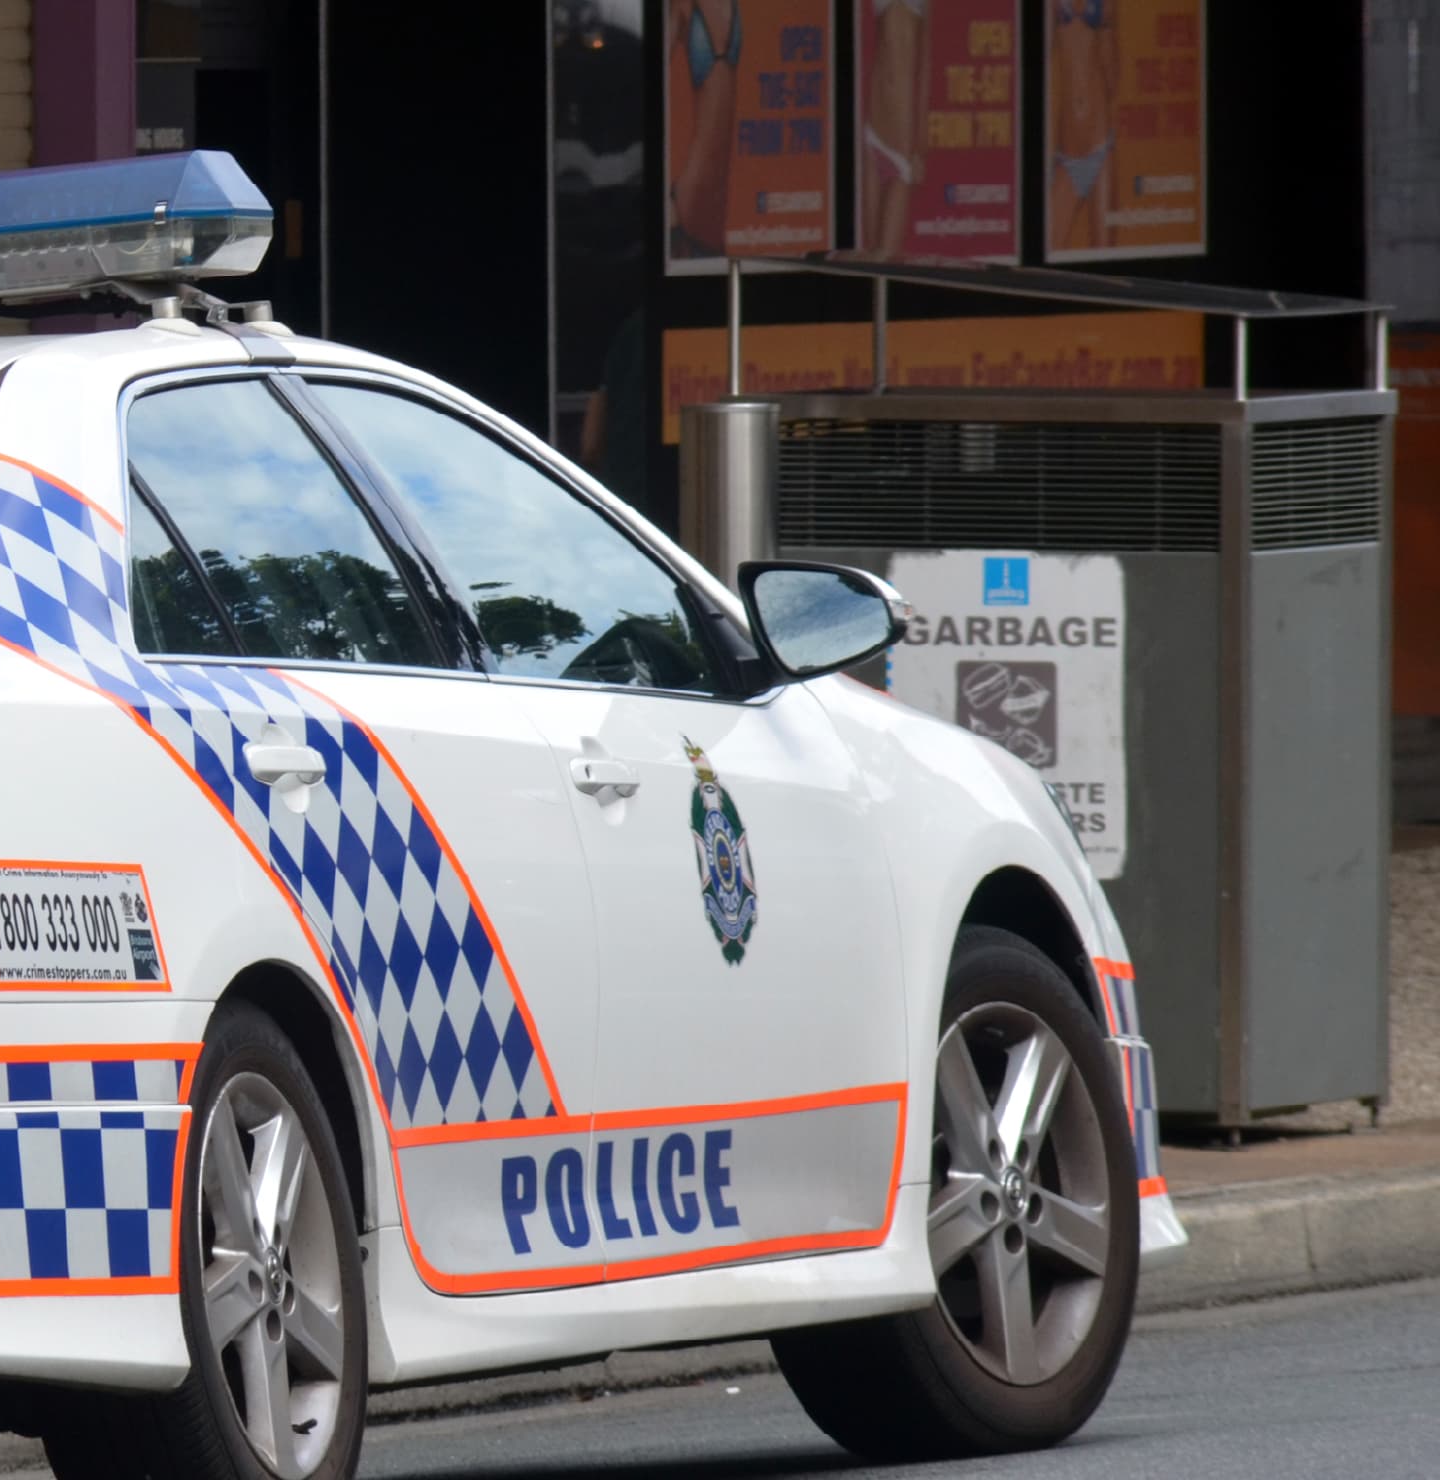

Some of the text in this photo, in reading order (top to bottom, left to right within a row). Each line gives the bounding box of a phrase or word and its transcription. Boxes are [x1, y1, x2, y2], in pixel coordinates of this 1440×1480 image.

[904, 615, 1118, 648] GARBAGE
[2, 867, 22, 877] Crime
[23, 869, 59, 878] Information
[41, 894, 80, 952] 333
[81, 895, 120, 953] 000
[501, 1129, 741, 1255] POLICE
